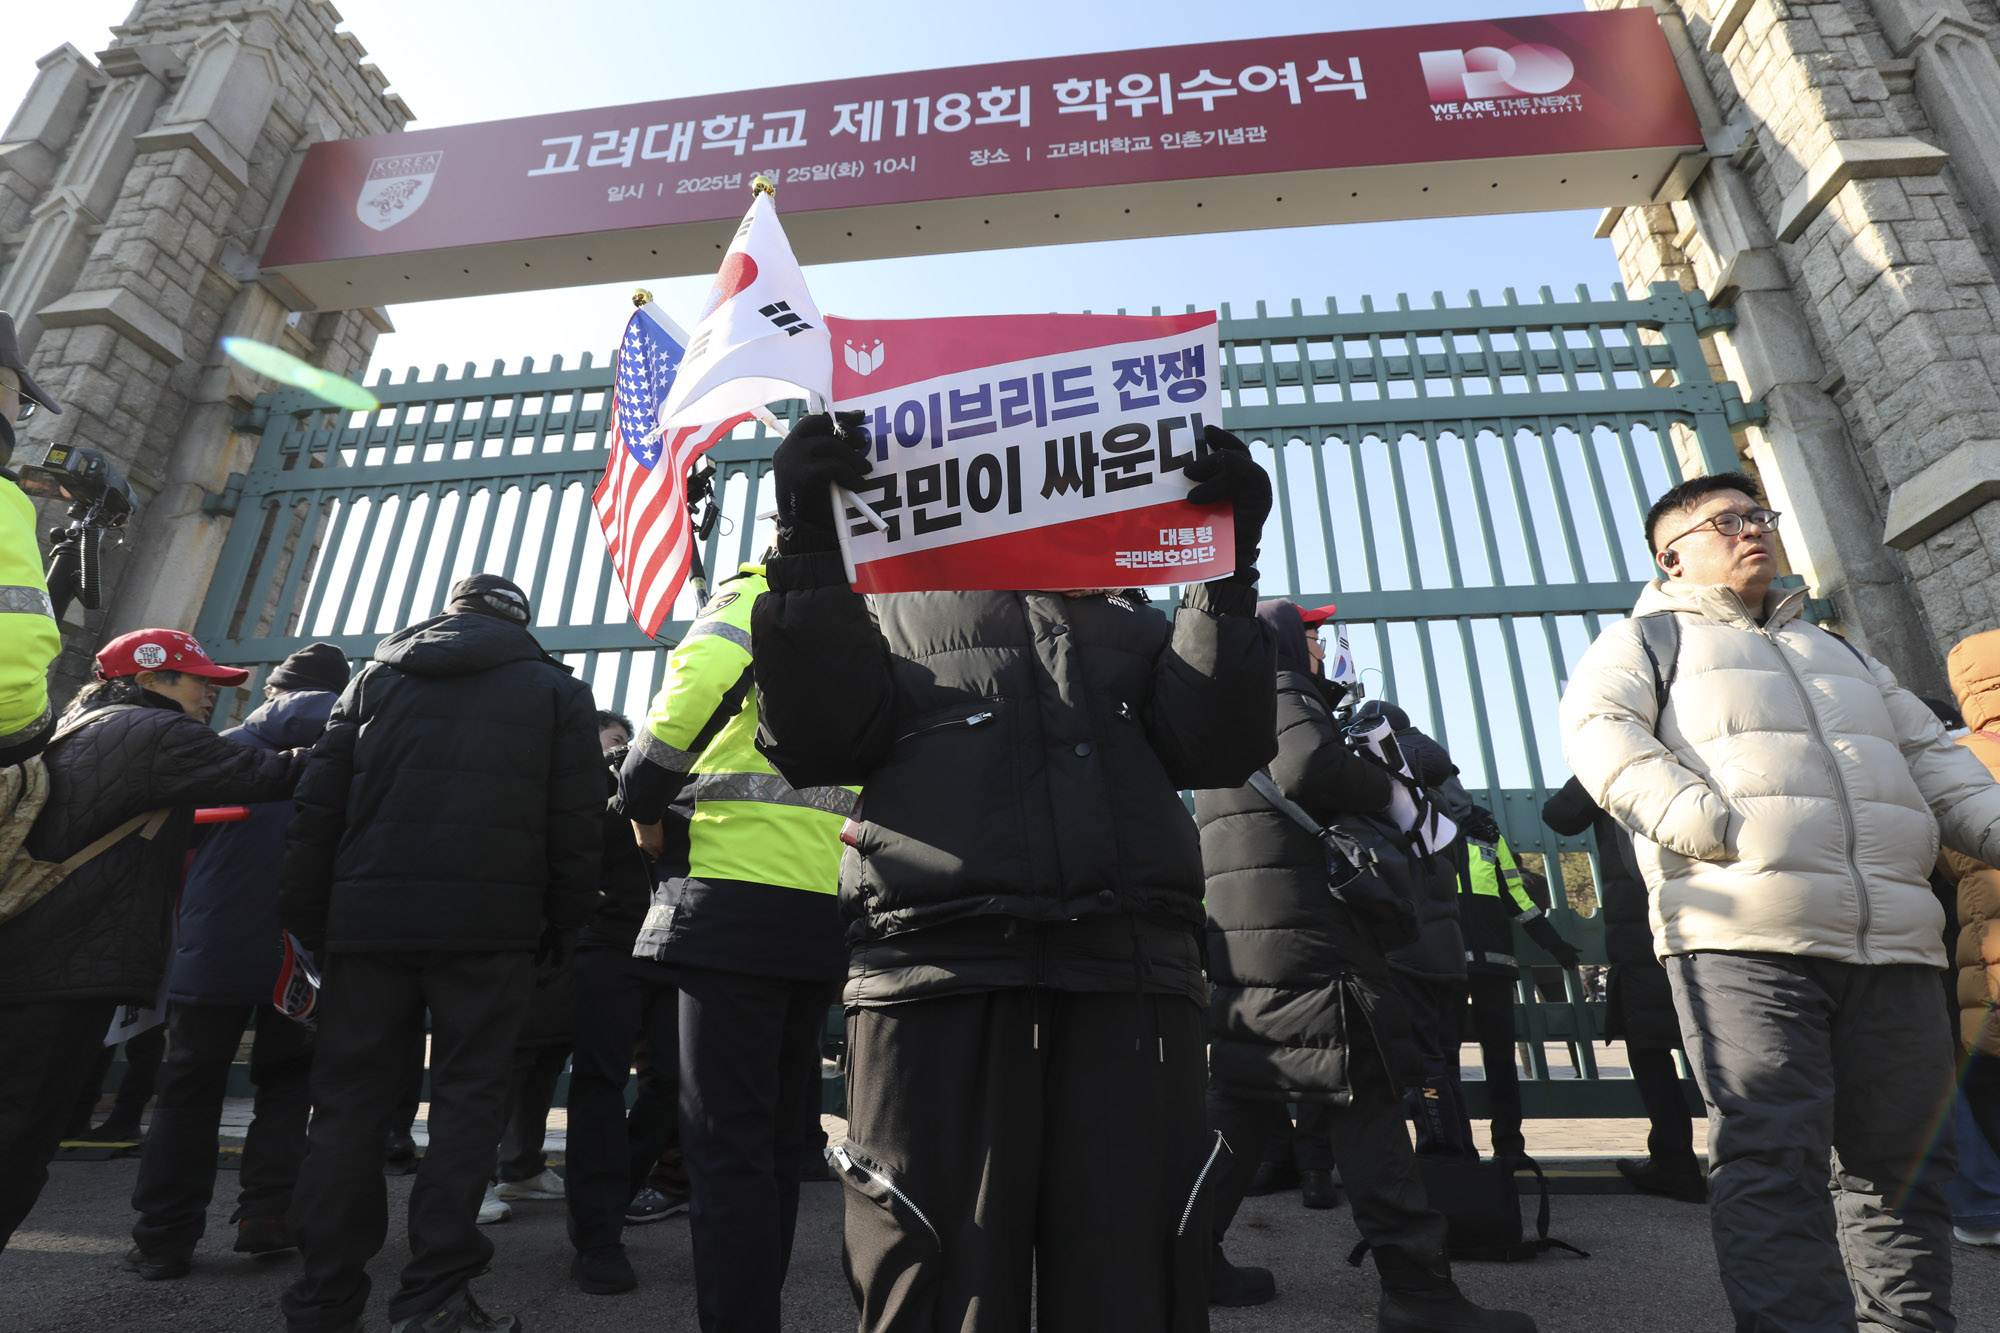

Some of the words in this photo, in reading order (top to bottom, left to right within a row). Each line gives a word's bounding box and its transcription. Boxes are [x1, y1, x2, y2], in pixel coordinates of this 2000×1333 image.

[527, 108, 807, 177] 고려대학교
[829, 85, 1031, 143] 제118회
[1052, 56, 1368, 122] 학위수여식
[1430, 103, 1458, 114] WE
[1462, 100, 1496, 113] ARE
[1497, 97, 1532, 110] THE
[1533, 94, 1582, 107] NEXT
[1434, 111, 1484, 122] KOREA
[1492, 105, 1583, 118] UNIVERSITY
[969, 147, 1011, 167] 장소
[1046, 135, 1153, 158] 고려대학교
[1159, 125, 1268, 150] 인촌기념관
[376, 155, 435, 171] KOREA
[607, 182, 645, 202] 일시
[675, 172, 742, 194] 2025년
[786, 159, 865, 183] 25일(화)
[873, 155, 917, 175] 10시
[1111, 343, 1208, 412] 전쟁
[845, 444, 1022, 543] 국민이
[1040, 412, 1209, 501] 싸운다
[1159, 525, 1213, 546] 대통령
[1114, 545, 1216, 569] 국민변호인단
